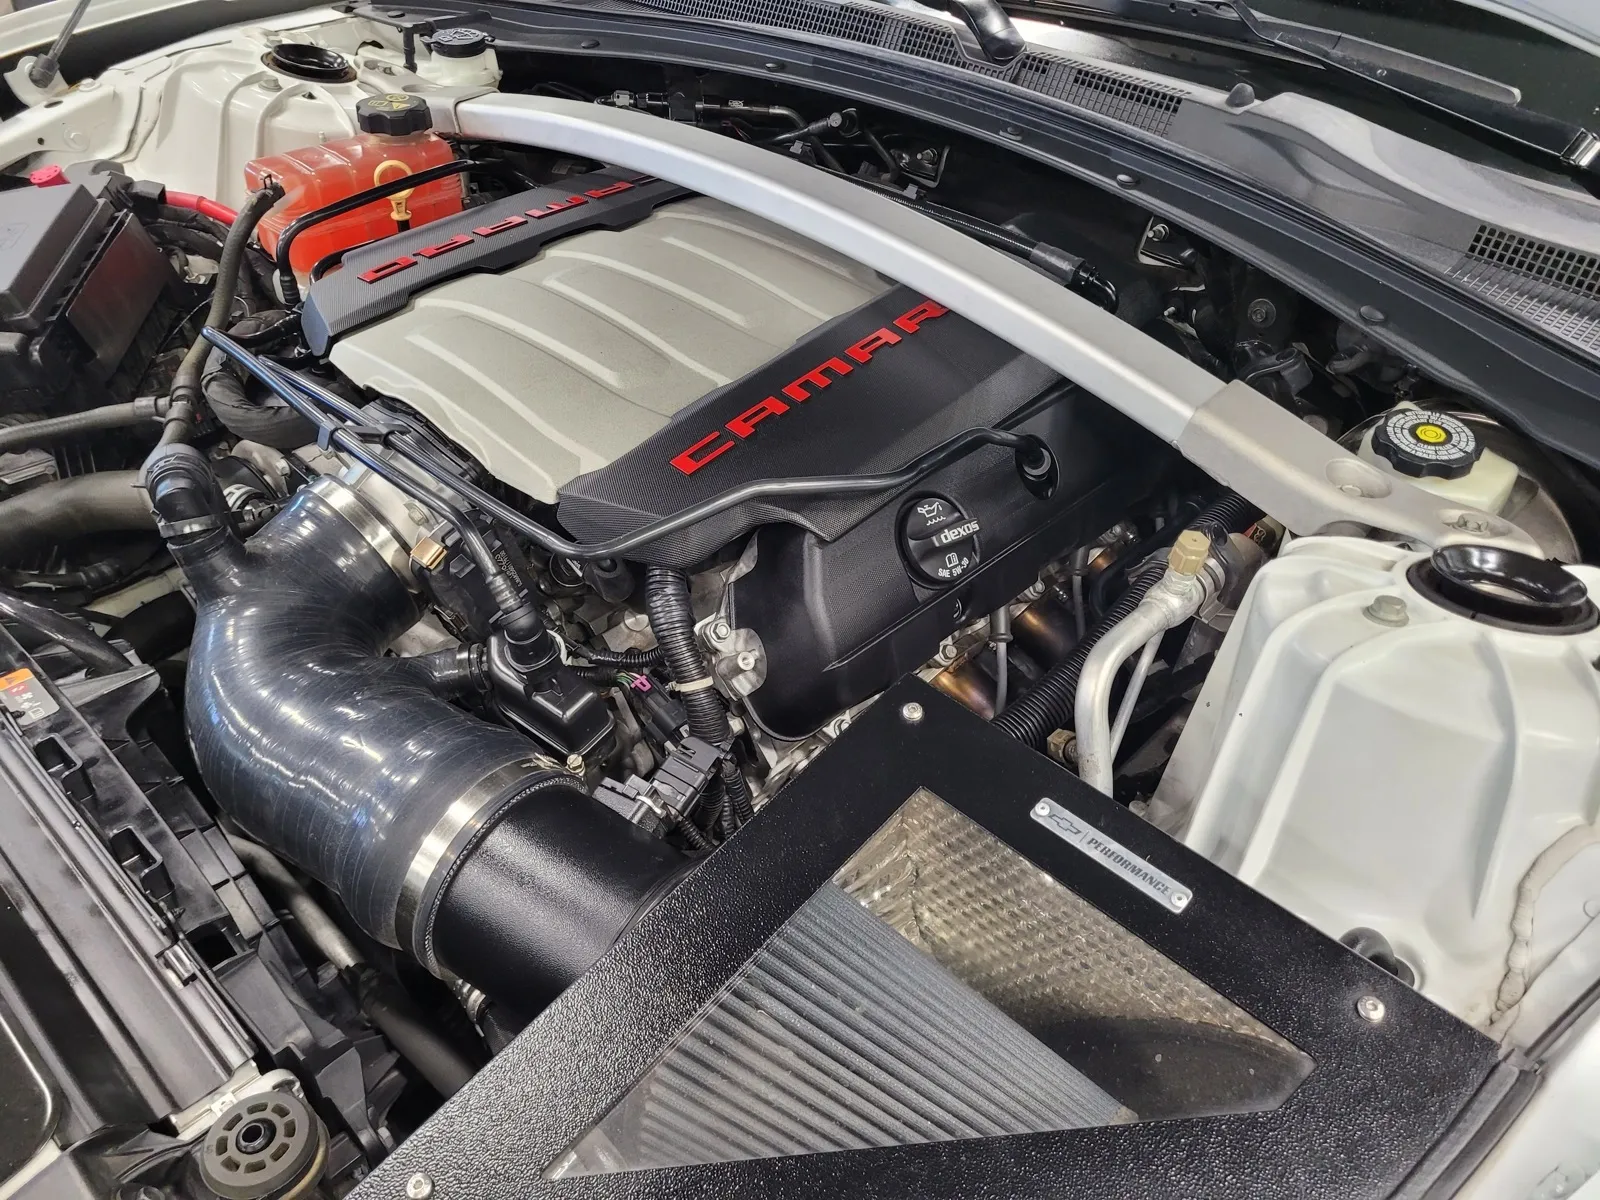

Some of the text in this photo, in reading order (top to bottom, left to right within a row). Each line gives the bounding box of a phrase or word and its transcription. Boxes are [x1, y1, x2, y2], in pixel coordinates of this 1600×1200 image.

[669, 297, 950, 475] CAMAR
[940, 520, 980, 543] dexos
[938, 557, 969, 578] SAE 5W-30
[1087, 837, 1171, 895] PERFORMANCE
